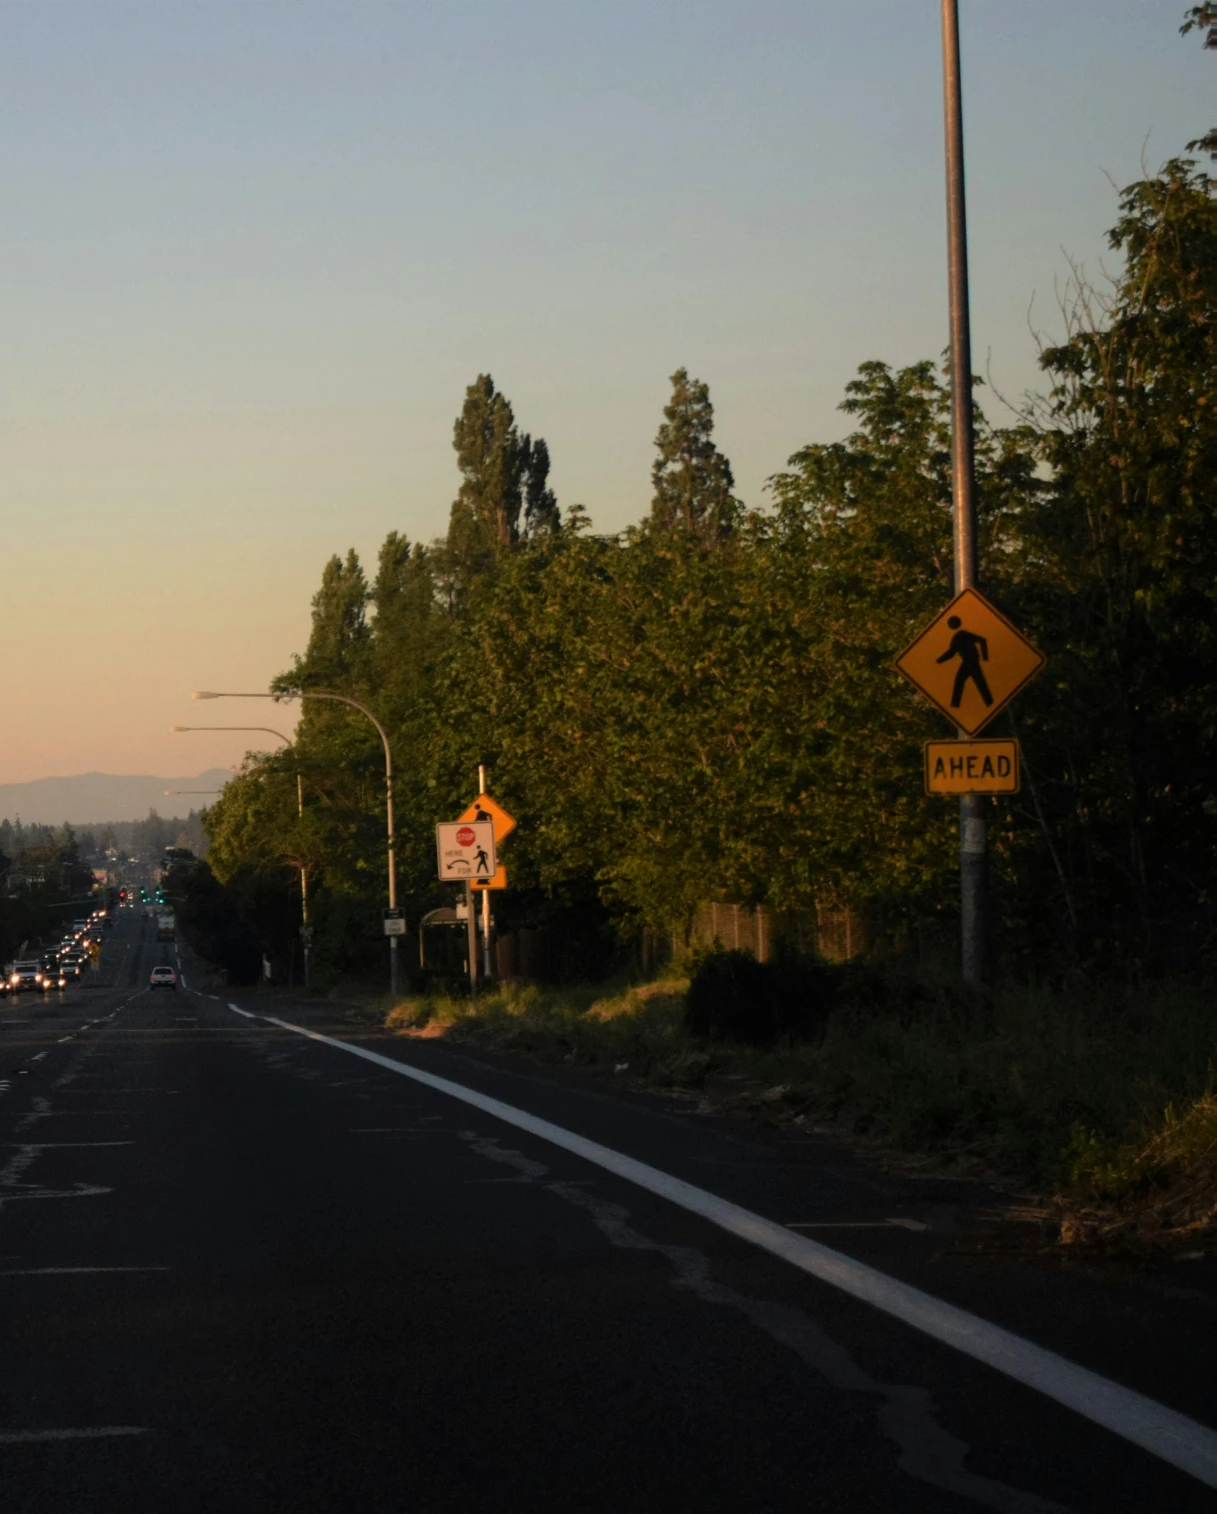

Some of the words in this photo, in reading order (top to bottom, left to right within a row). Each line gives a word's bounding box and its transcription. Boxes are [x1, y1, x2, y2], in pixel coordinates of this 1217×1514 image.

[934, 755, 1011, 779] AHEAD
[457, 832, 474, 841] STOP
[458, 867, 471, 875] FOR
